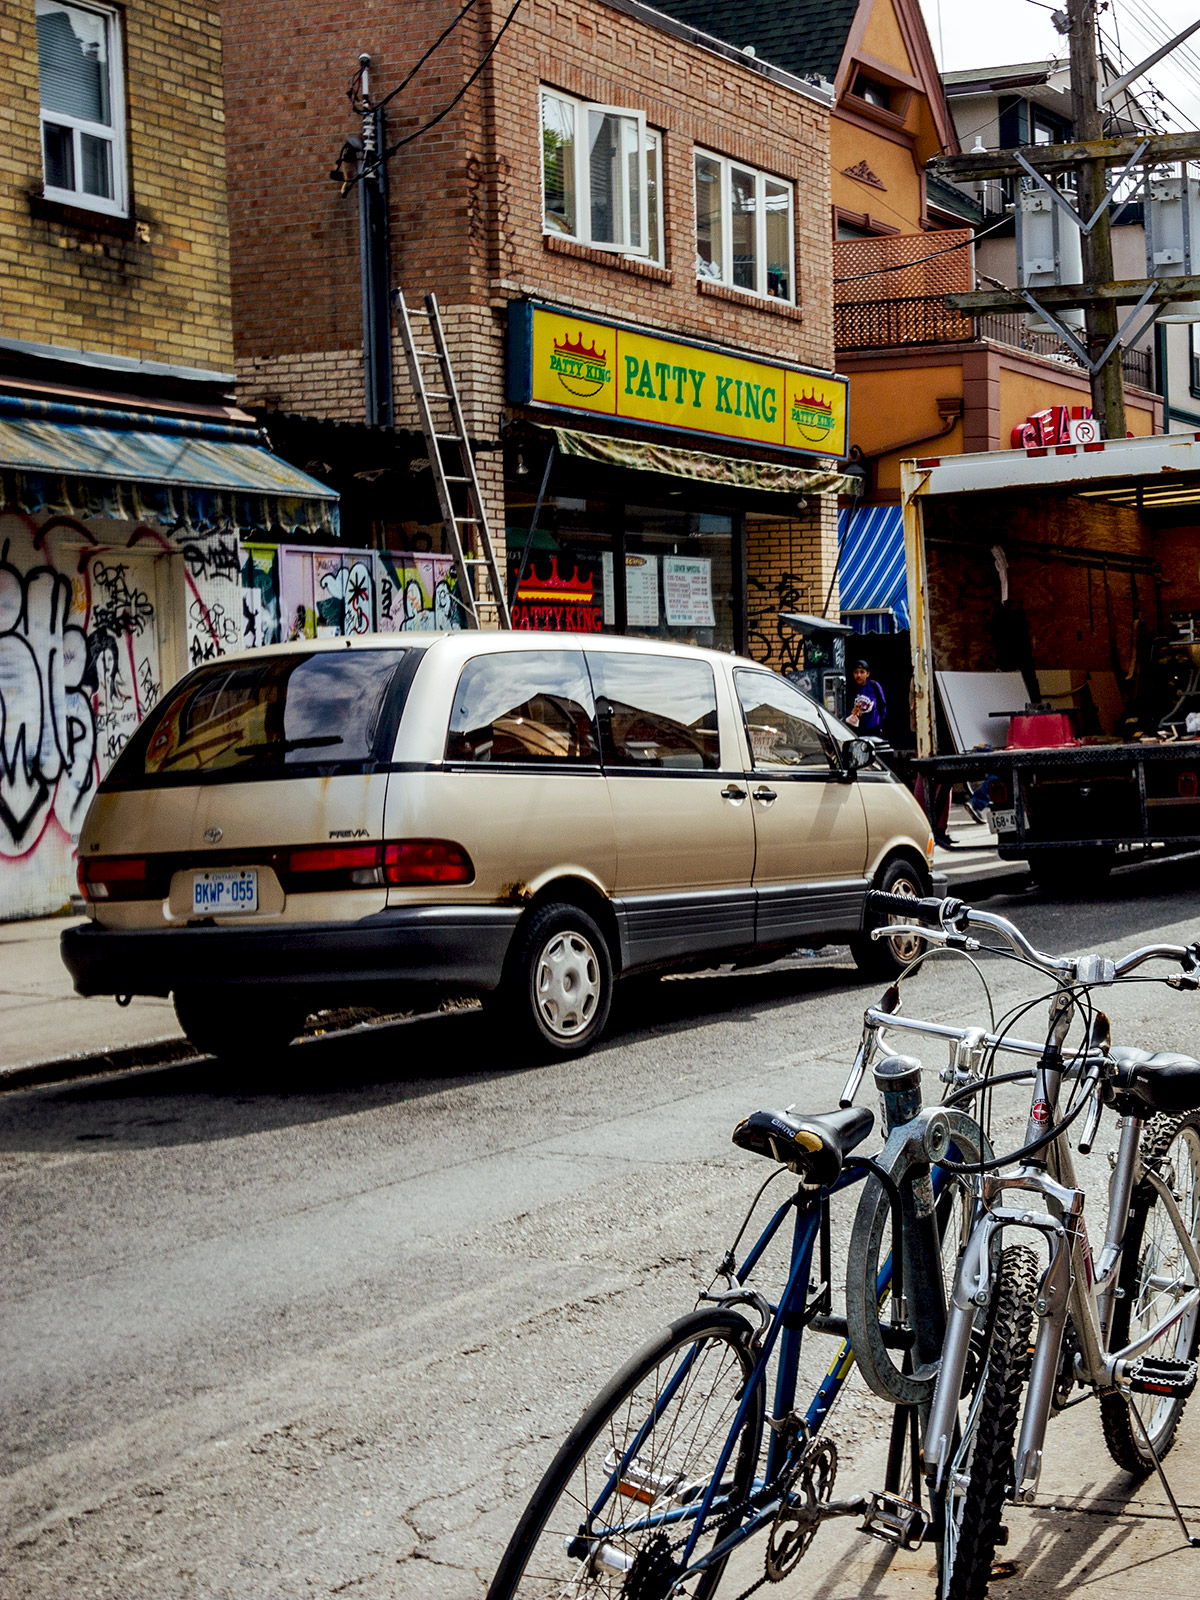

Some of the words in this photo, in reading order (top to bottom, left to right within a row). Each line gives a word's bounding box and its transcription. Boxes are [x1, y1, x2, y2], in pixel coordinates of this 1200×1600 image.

[550, 354, 584, 377] PATTY
[585, 363, 612, 383] KING
[623, 354, 706, 408] PATTY
[715, 374, 778, 424] KING
[791, 407, 816, 425] PATTY
[816, 413, 836, 429] KING
[511, 604, 564, 631] PATTY
[564, 606, 602, 632] KING
[328, 829, 370, 839] PREVIA
